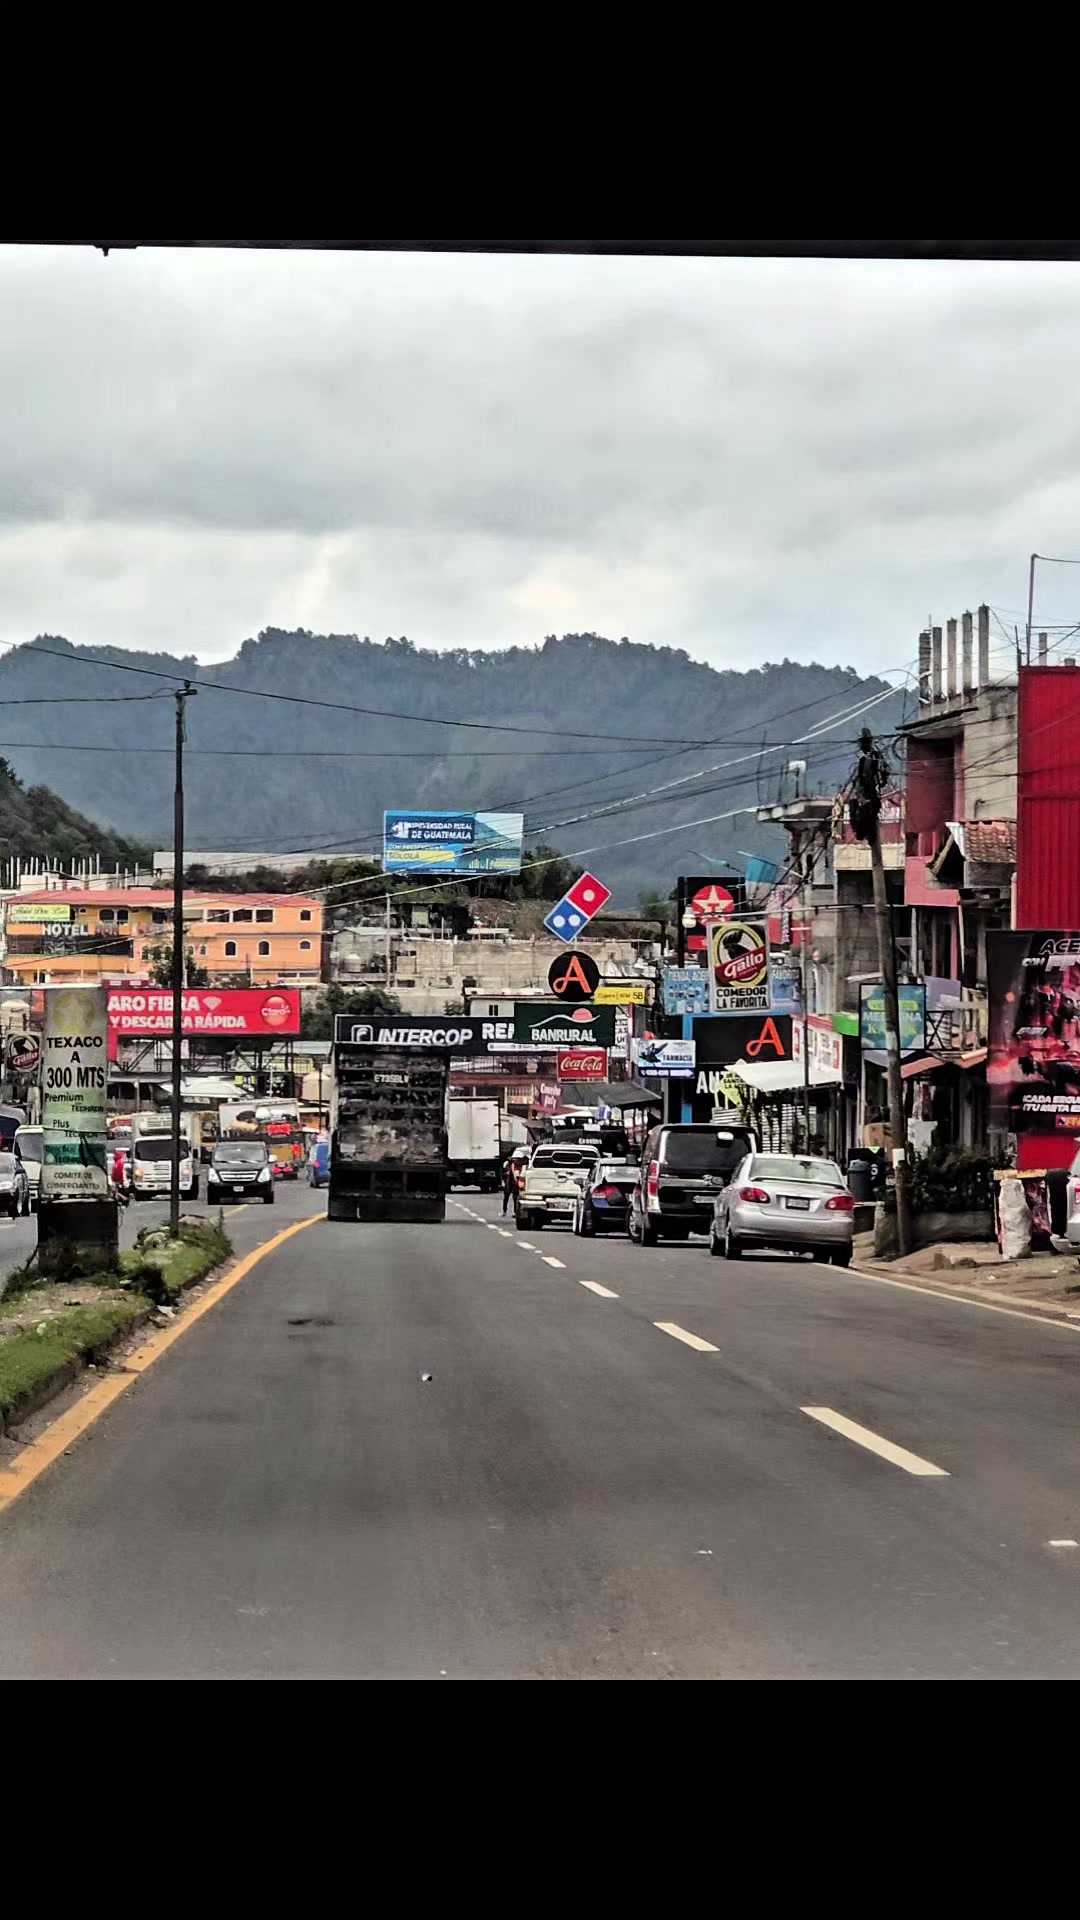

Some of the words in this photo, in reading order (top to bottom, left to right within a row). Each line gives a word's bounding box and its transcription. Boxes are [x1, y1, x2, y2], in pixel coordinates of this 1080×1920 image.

[411, 830, 422, 839] DE
[423, 831, 472, 839] GUATEMALA
[42, 923, 89, 936] HOTEL
[716, 986, 767, 998] COMEDOR
[149, 995, 200, 1011] FIBA
[716, 998, 727, 1009] LA
[730, 996, 767, 1009] FAVORITA
[109, 1016, 120, 1028] Y
[122, 1015, 193, 1029] DESCARA
[195, 1013, 246, 1029] RÁPIDA
[378, 1028, 473, 1046] INTERCOP
[531, 1028, 597, 1042] BANRURAL
[46, 1036, 103, 1048] TEXACO
[70, 1050, 81, 1063] A
[46, 1066, 72, 1089] 300
[77, 1066, 105, 1088] MTS
[44, 1092, 84, 1102] Premium
[52, 1119, 70, 1128] Plus
